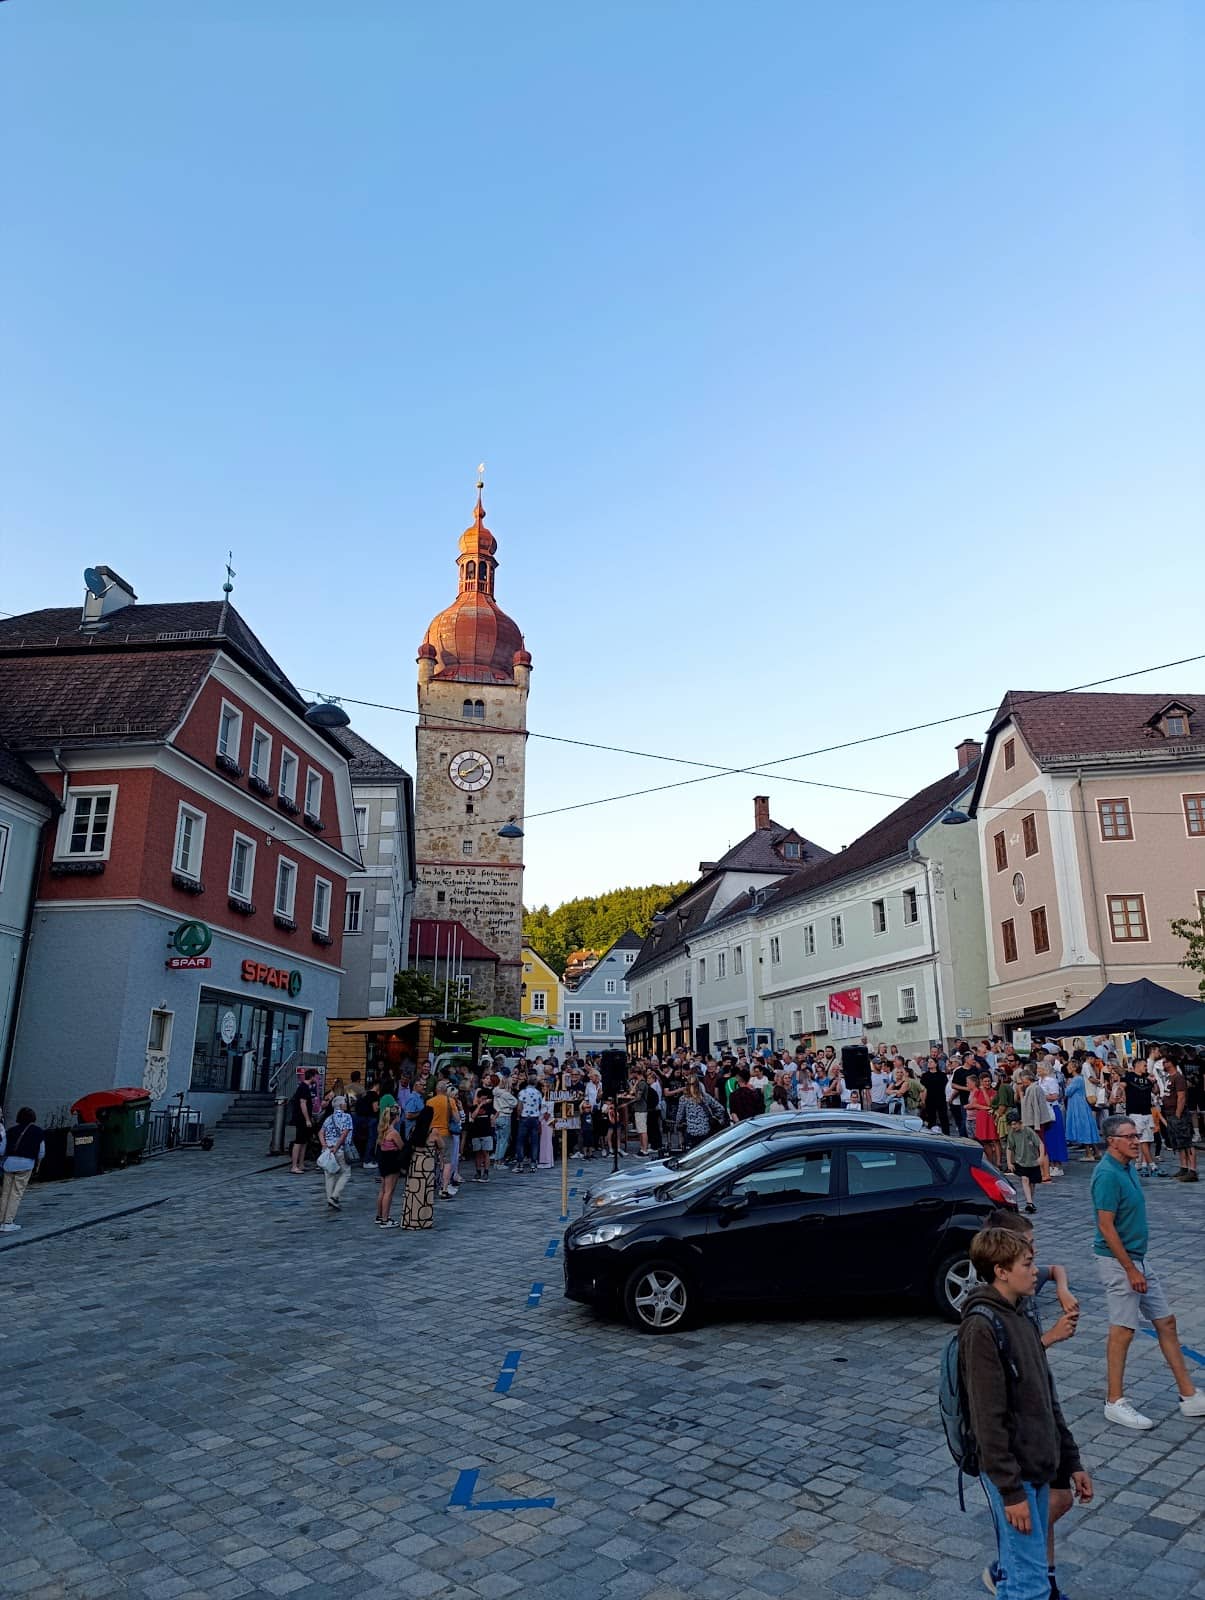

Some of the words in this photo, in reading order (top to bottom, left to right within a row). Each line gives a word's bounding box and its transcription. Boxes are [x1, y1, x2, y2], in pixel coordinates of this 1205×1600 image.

[433, 867, 452, 876] Jahre
[456, 868, 476, 876] 1532
[172, 958, 206, 967] SPAR
[242, 959, 290, 991] SPAR
